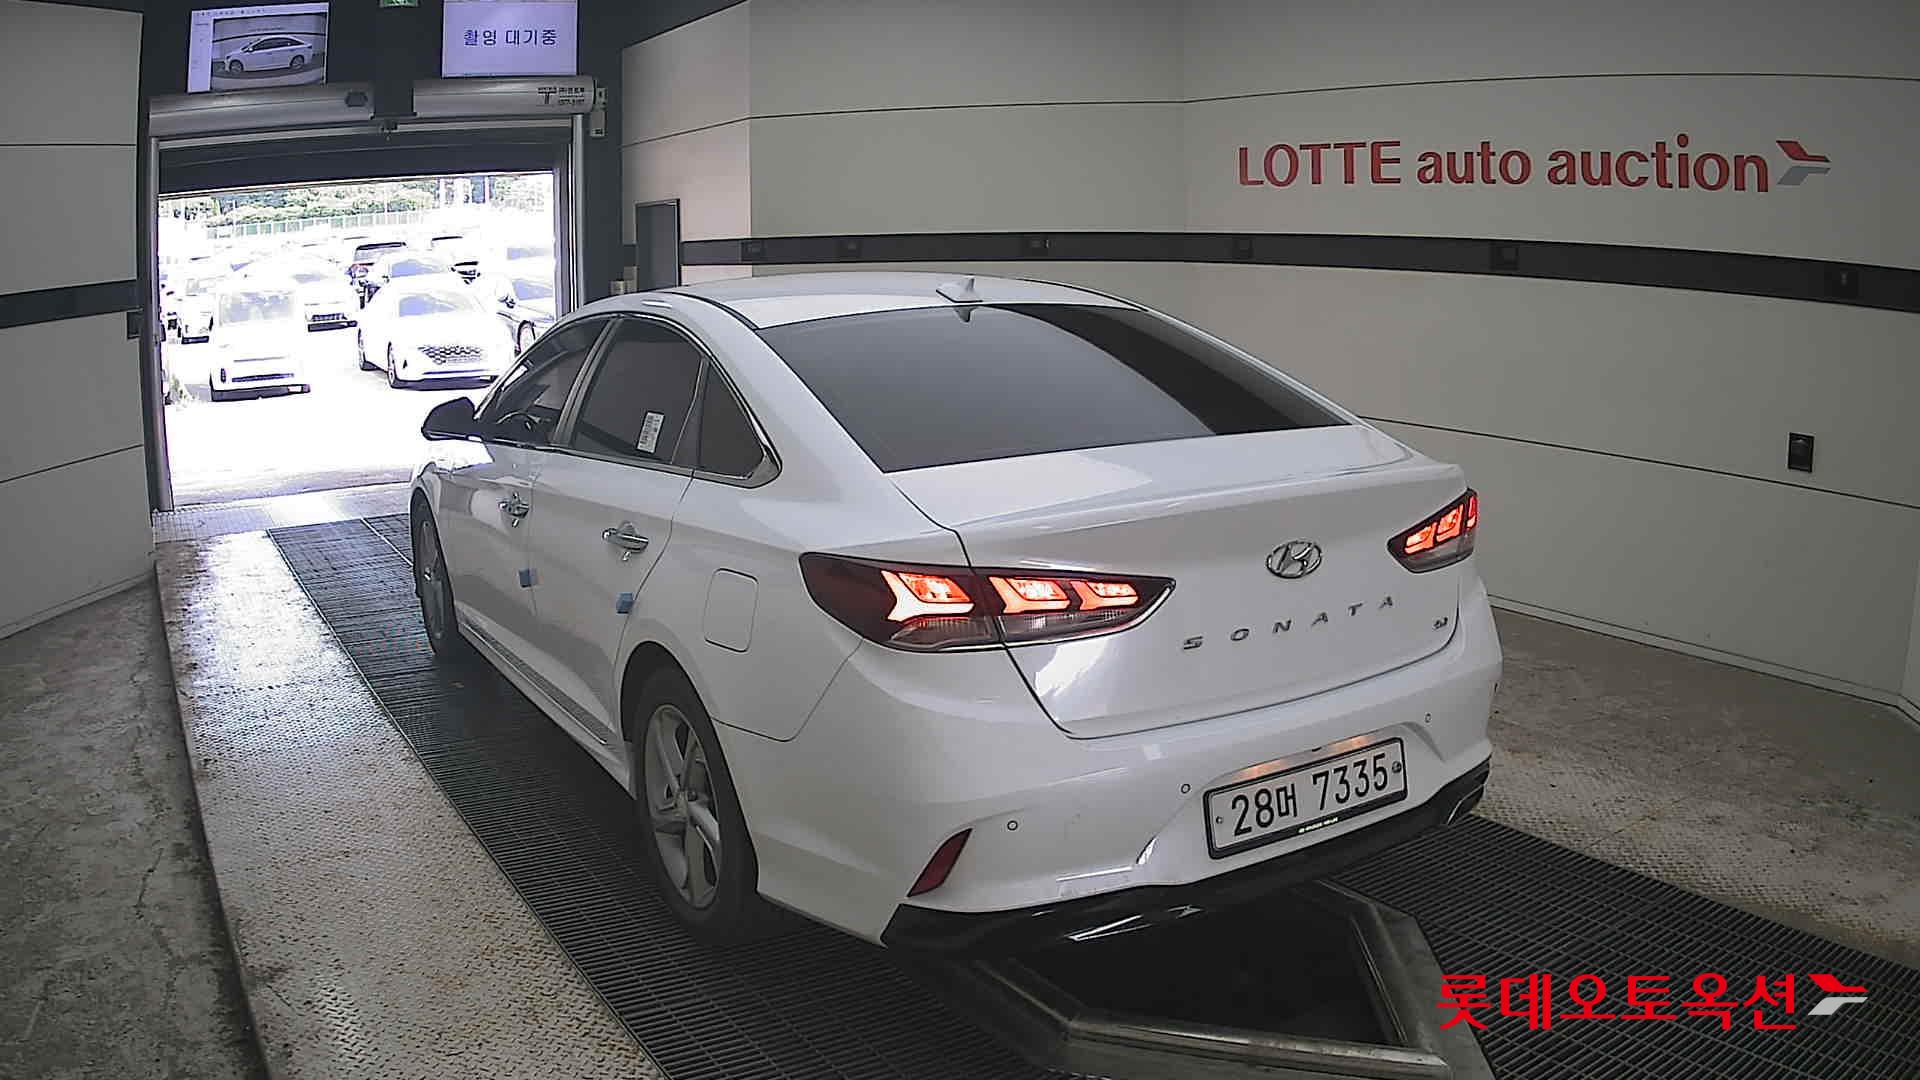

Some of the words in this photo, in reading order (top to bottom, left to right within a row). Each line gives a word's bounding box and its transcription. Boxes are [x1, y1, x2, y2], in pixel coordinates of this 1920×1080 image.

[505, 29, 557, 46] 대기중
[1239, 140, 1401, 187] LOTTE
[1416, 141, 1532, 186] auto
[1547, 133, 1769, 193] auction
[1183, 596, 1394, 650] SONATA
[1231, 783, 1298, 836] 28머
[1312, 753, 1388, 811] 7335
